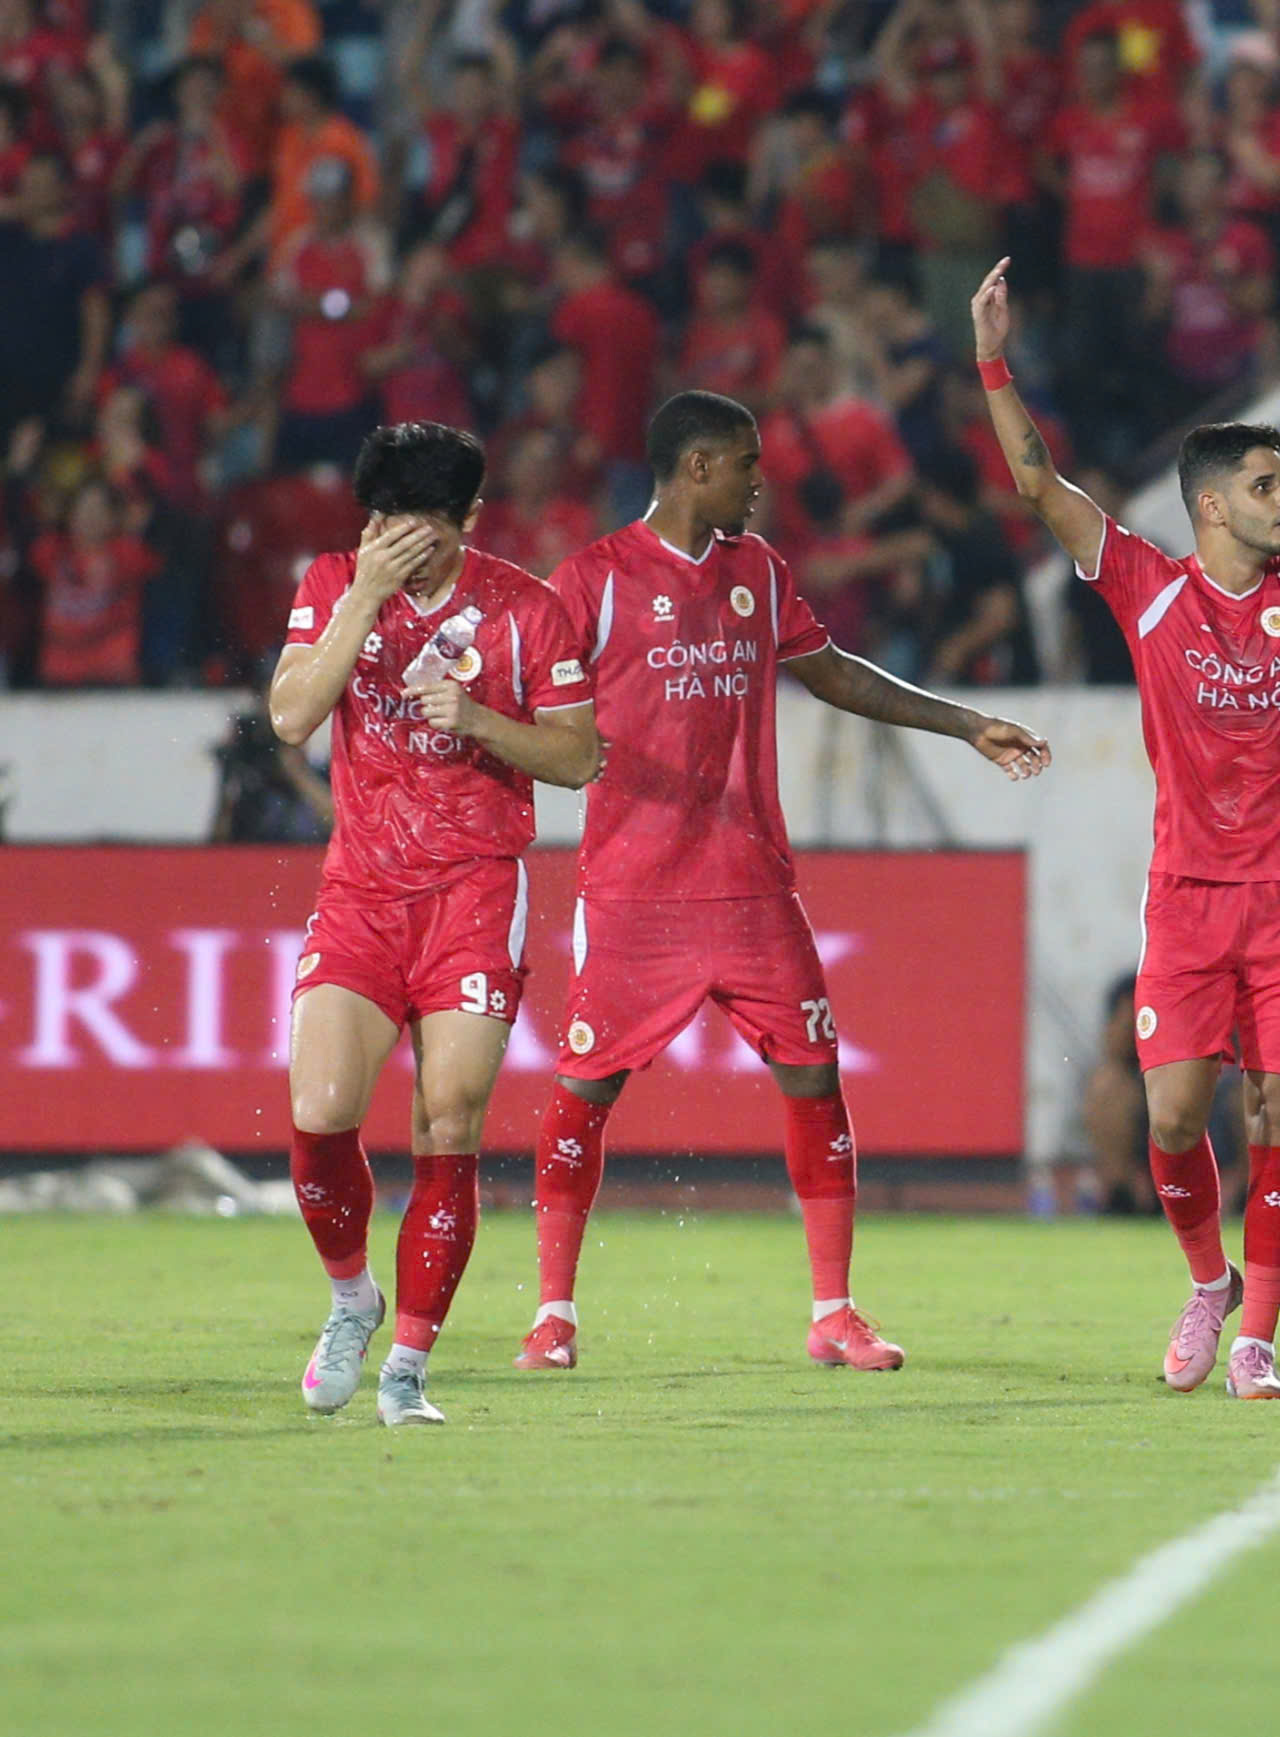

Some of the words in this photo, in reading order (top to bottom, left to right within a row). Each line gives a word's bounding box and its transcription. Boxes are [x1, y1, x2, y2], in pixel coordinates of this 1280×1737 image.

[647, 640, 727, 669] CÔNG
[732, 640, 757, 663] AN
[1184, 648, 1263, 685] CÔNG
[664, 672, 706, 701] HÀ
[714, 667, 749, 701] NỘI
[1197, 682, 1239, 710] HÀ
[460, 972, 487, 1014] 9
[800, 997, 836, 1043] 72
